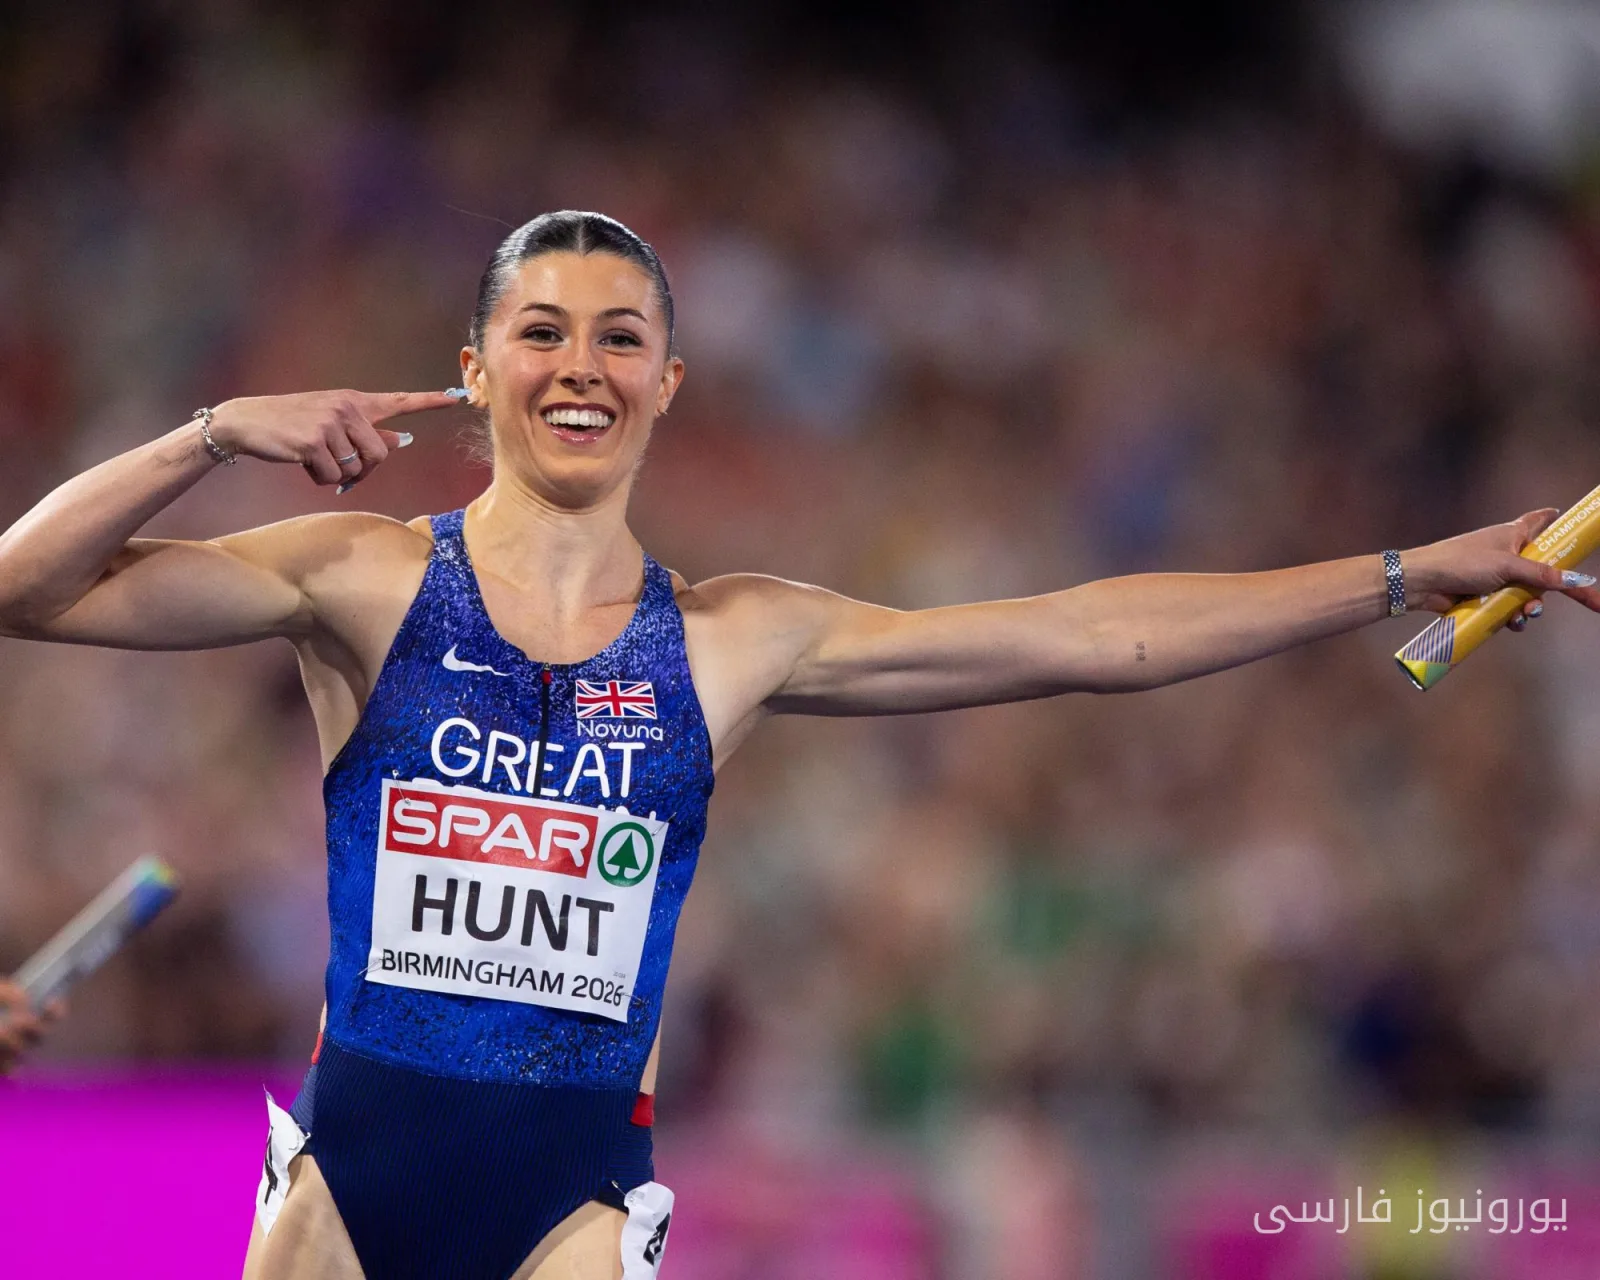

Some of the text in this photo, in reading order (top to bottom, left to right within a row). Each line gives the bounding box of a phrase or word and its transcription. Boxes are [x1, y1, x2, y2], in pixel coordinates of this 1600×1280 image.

[431, 717, 646, 798] GREAT
[576, 719, 664, 742] Novuna
[392, 799, 590, 867] SPAR
[411, 874, 615, 957] HUNT
[381, 948, 625, 1007] BIRMINGHAM 2026
